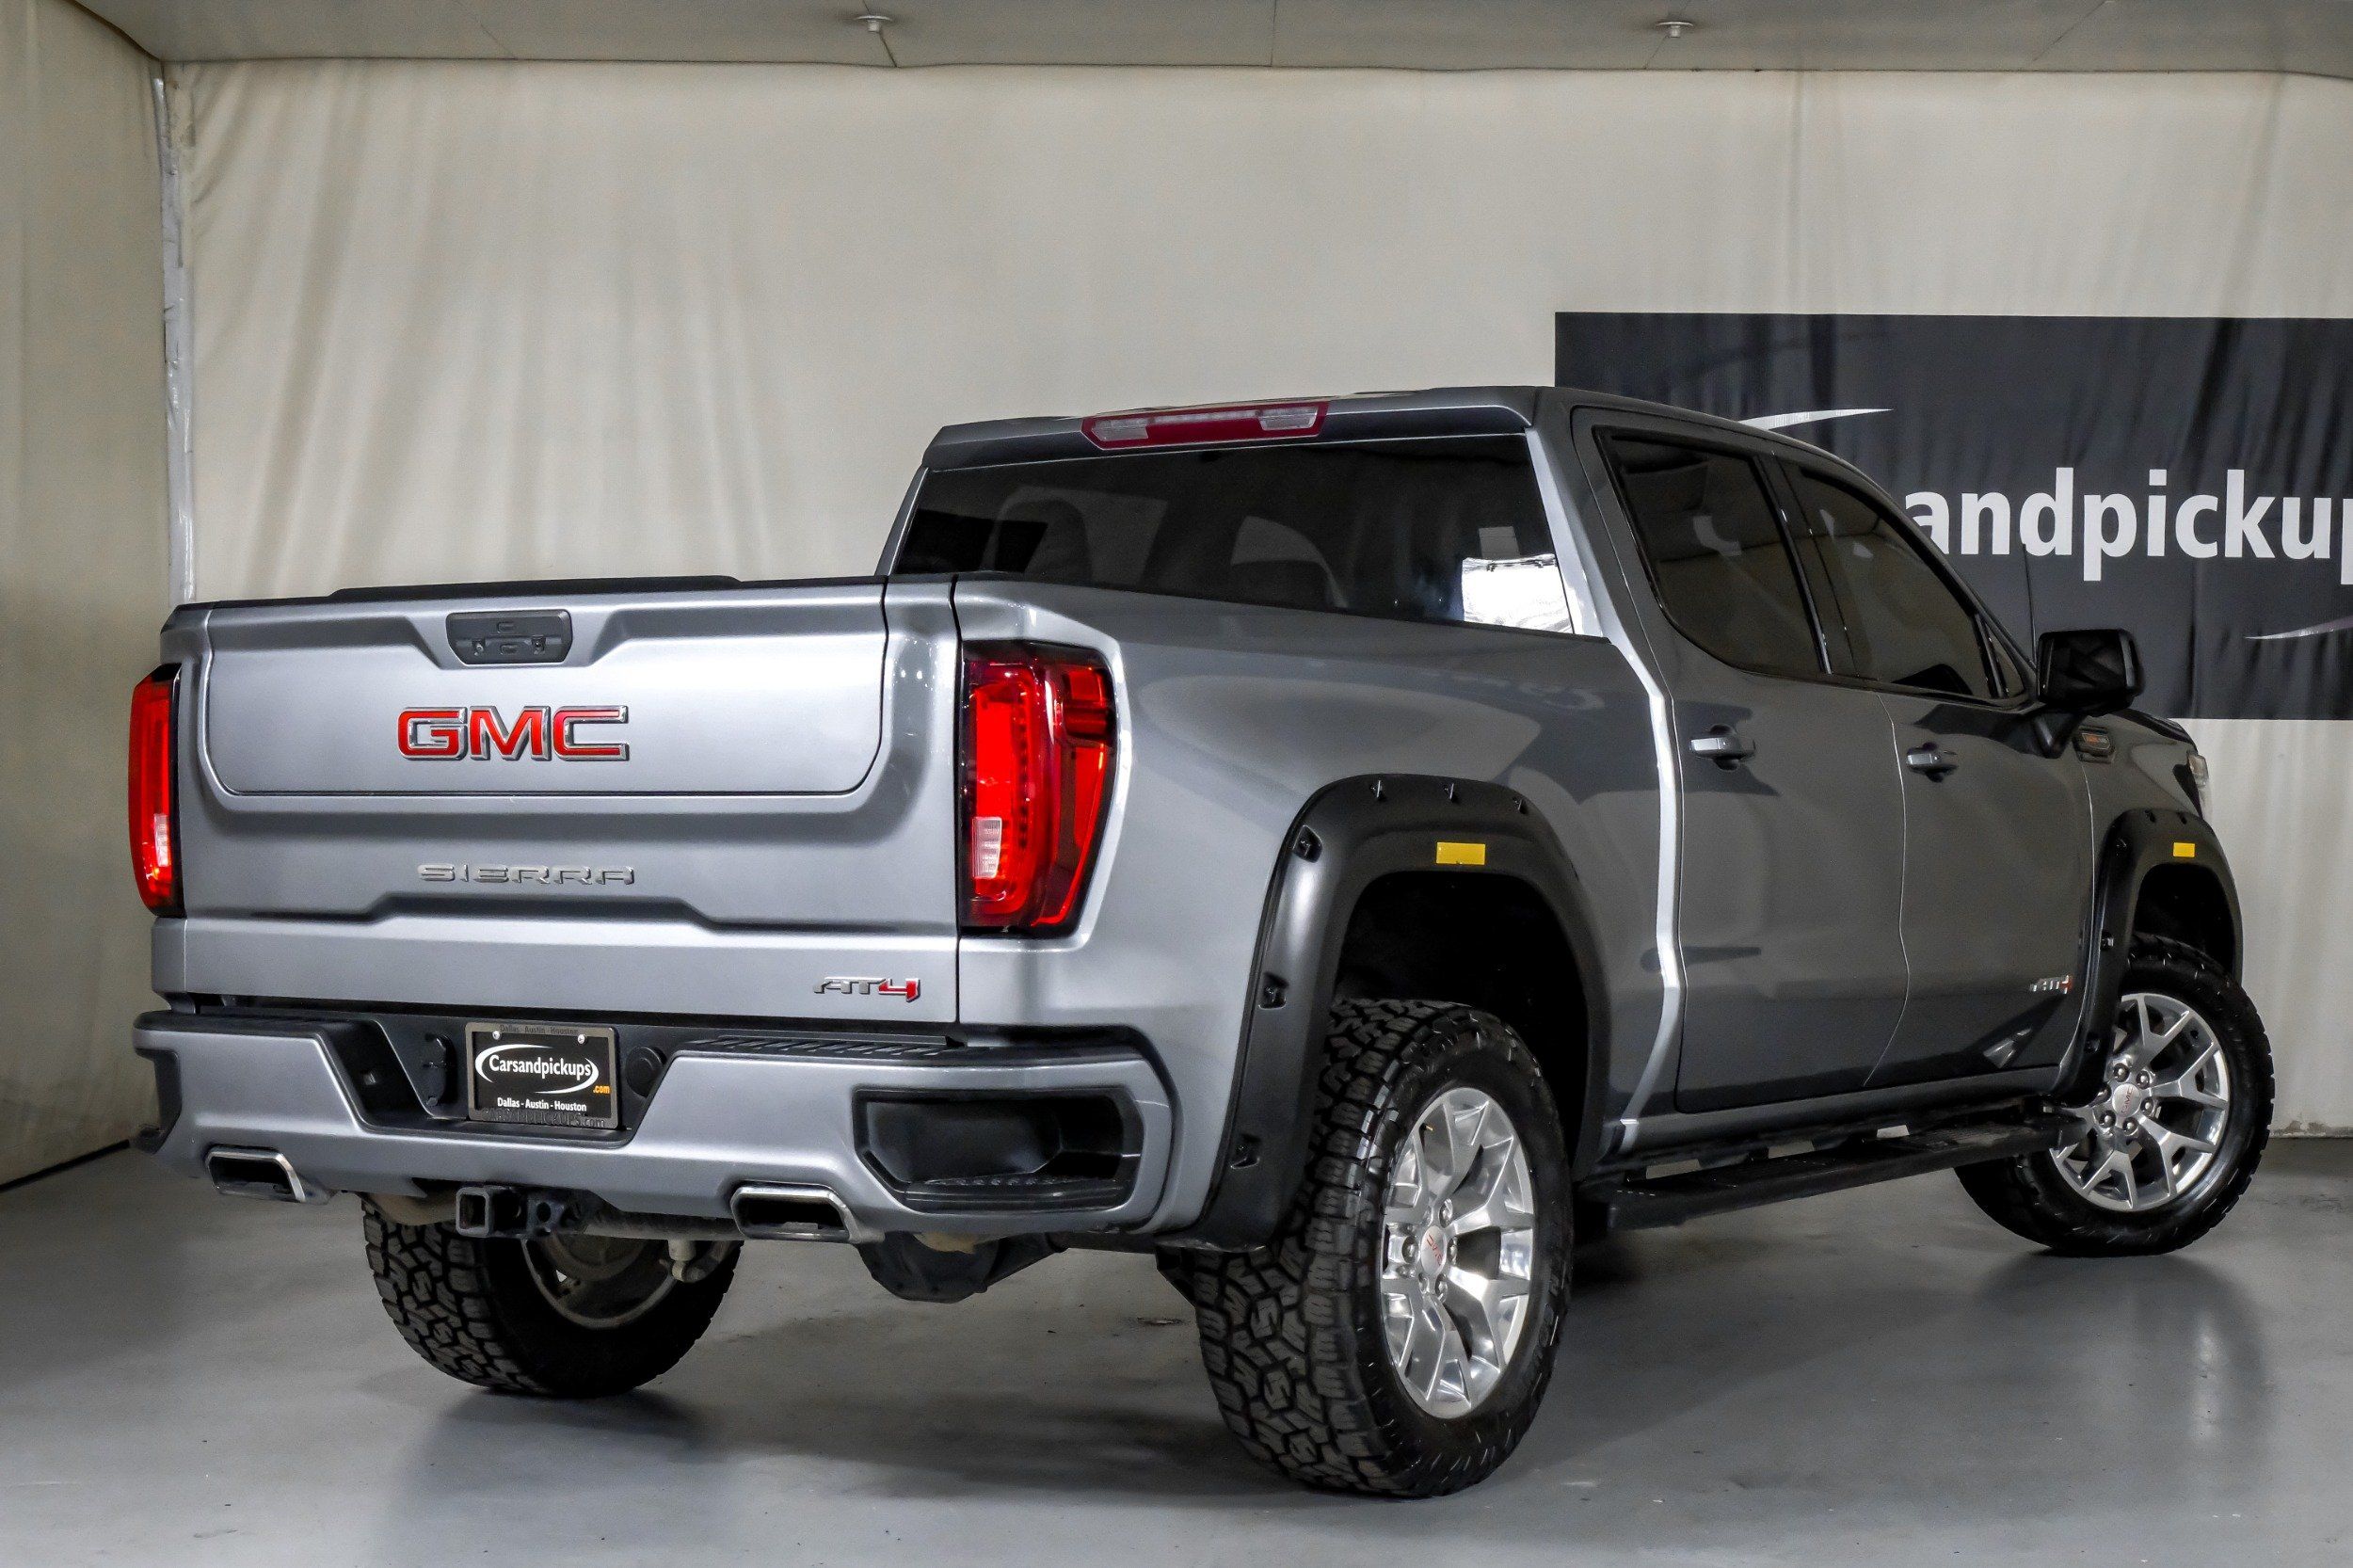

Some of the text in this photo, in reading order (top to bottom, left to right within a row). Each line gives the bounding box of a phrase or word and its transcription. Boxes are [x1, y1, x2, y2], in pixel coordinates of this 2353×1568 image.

[1904, 467, 2353, 585] andpicku
[397, 705, 630, 761] GMC
[417, 864, 634, 885] SIERRA
[813, 976, 920, 1002] AT4
[488, 1054, 592, 1080] Carsandpickups
[593, 1084, 610, 1095] .com
[497, 1097, 520, 1108] Dallas
[525, 1098, 549, 1110] Austin
[553, 1100, 587, 1112] Houston
